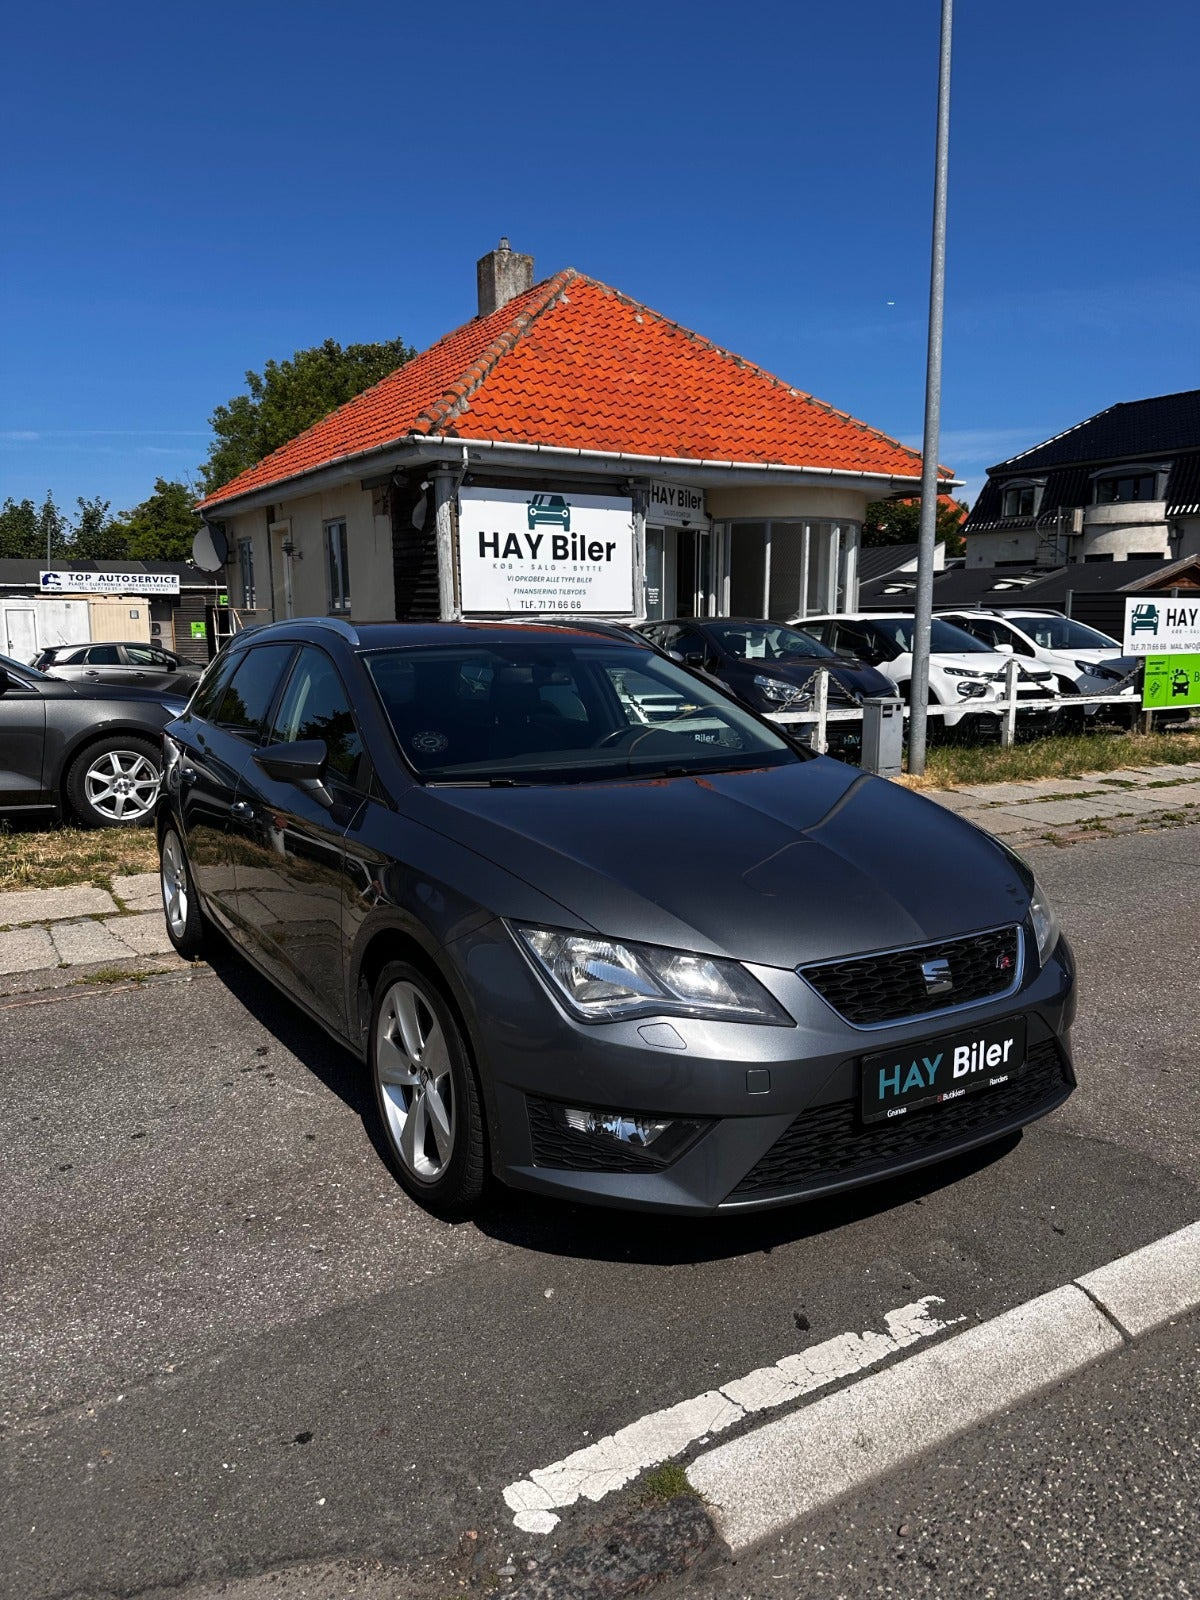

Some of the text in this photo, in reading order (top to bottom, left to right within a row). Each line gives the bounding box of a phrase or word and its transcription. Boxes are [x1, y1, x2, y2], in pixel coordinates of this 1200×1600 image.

[652, 484, 702, 510] HAY Biler
[478, 531, 616, 562] HAY Biler
[68, 573, 177, 584] TOP AUTOSERVICE
[559, 588, 586, 596] TILBYDES
[520, 600, 581, 609] TLF. 71 71 66 66
[1166, 608, 1198, 626] HAY
[878, 1038, 1014, 1100] HAY Biler
